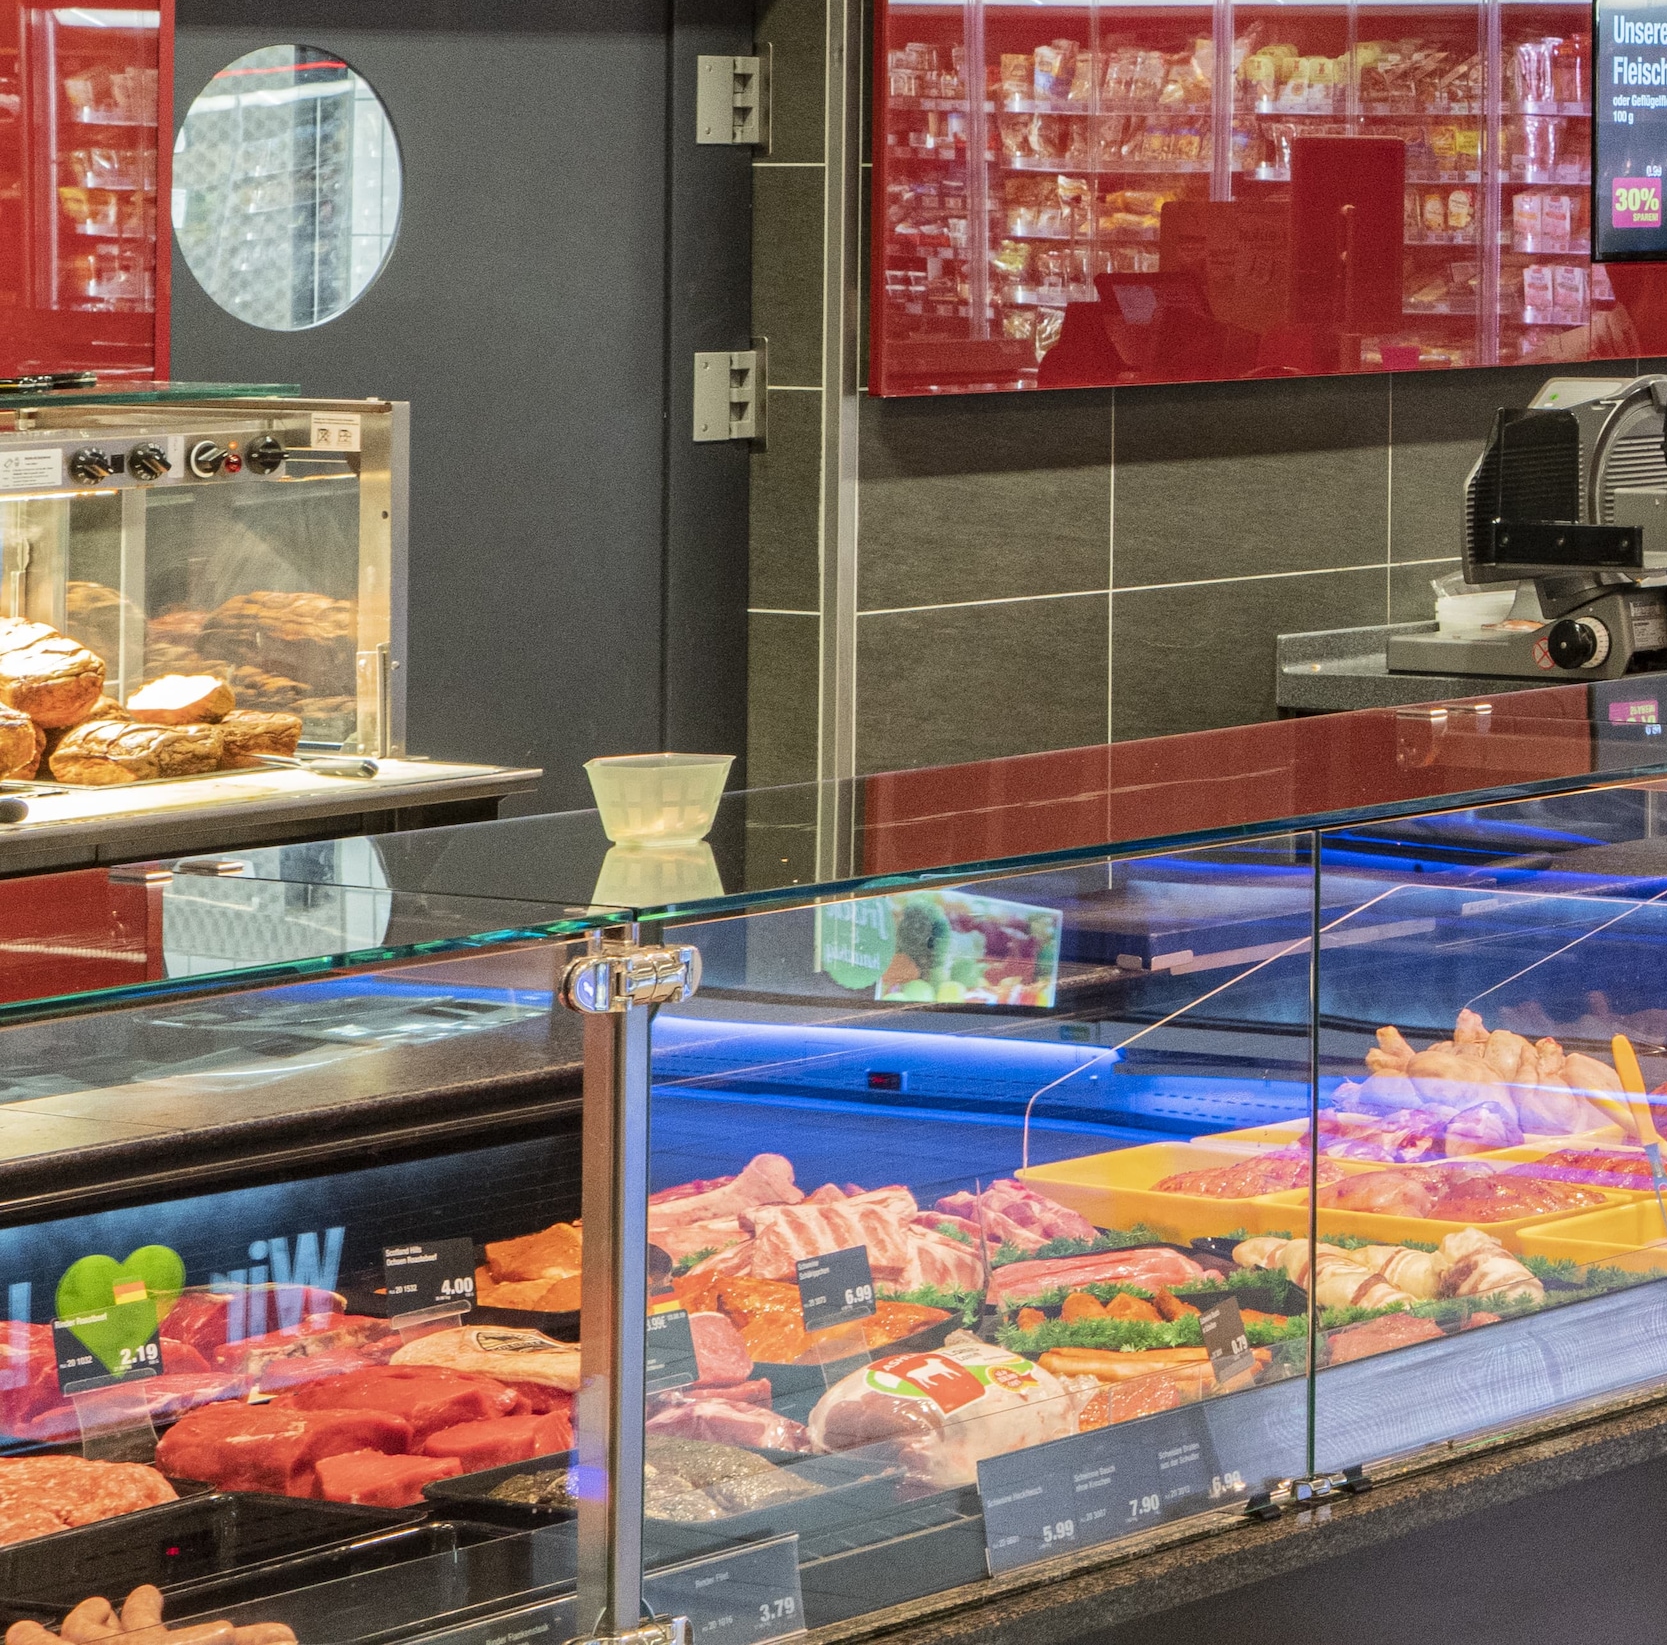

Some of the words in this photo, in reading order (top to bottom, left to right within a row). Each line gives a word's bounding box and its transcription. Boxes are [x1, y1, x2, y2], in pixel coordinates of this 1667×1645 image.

[1613, 95, 1631, 107] oder
[1613, 110, 1627, 123] 100
[1615, 187, 1660, 211] 30%
[441, 1277, 474, 1295] 4.00
[845, 1284, 872, 1305] 6.99
[120, 1343, 158, 1365] 2.19
[1129, 1494, 1160, 1517] 7.90
[1043, 1520, 1074, 1543] 5.99
[759, 1596, 795, 1623] 3.79
